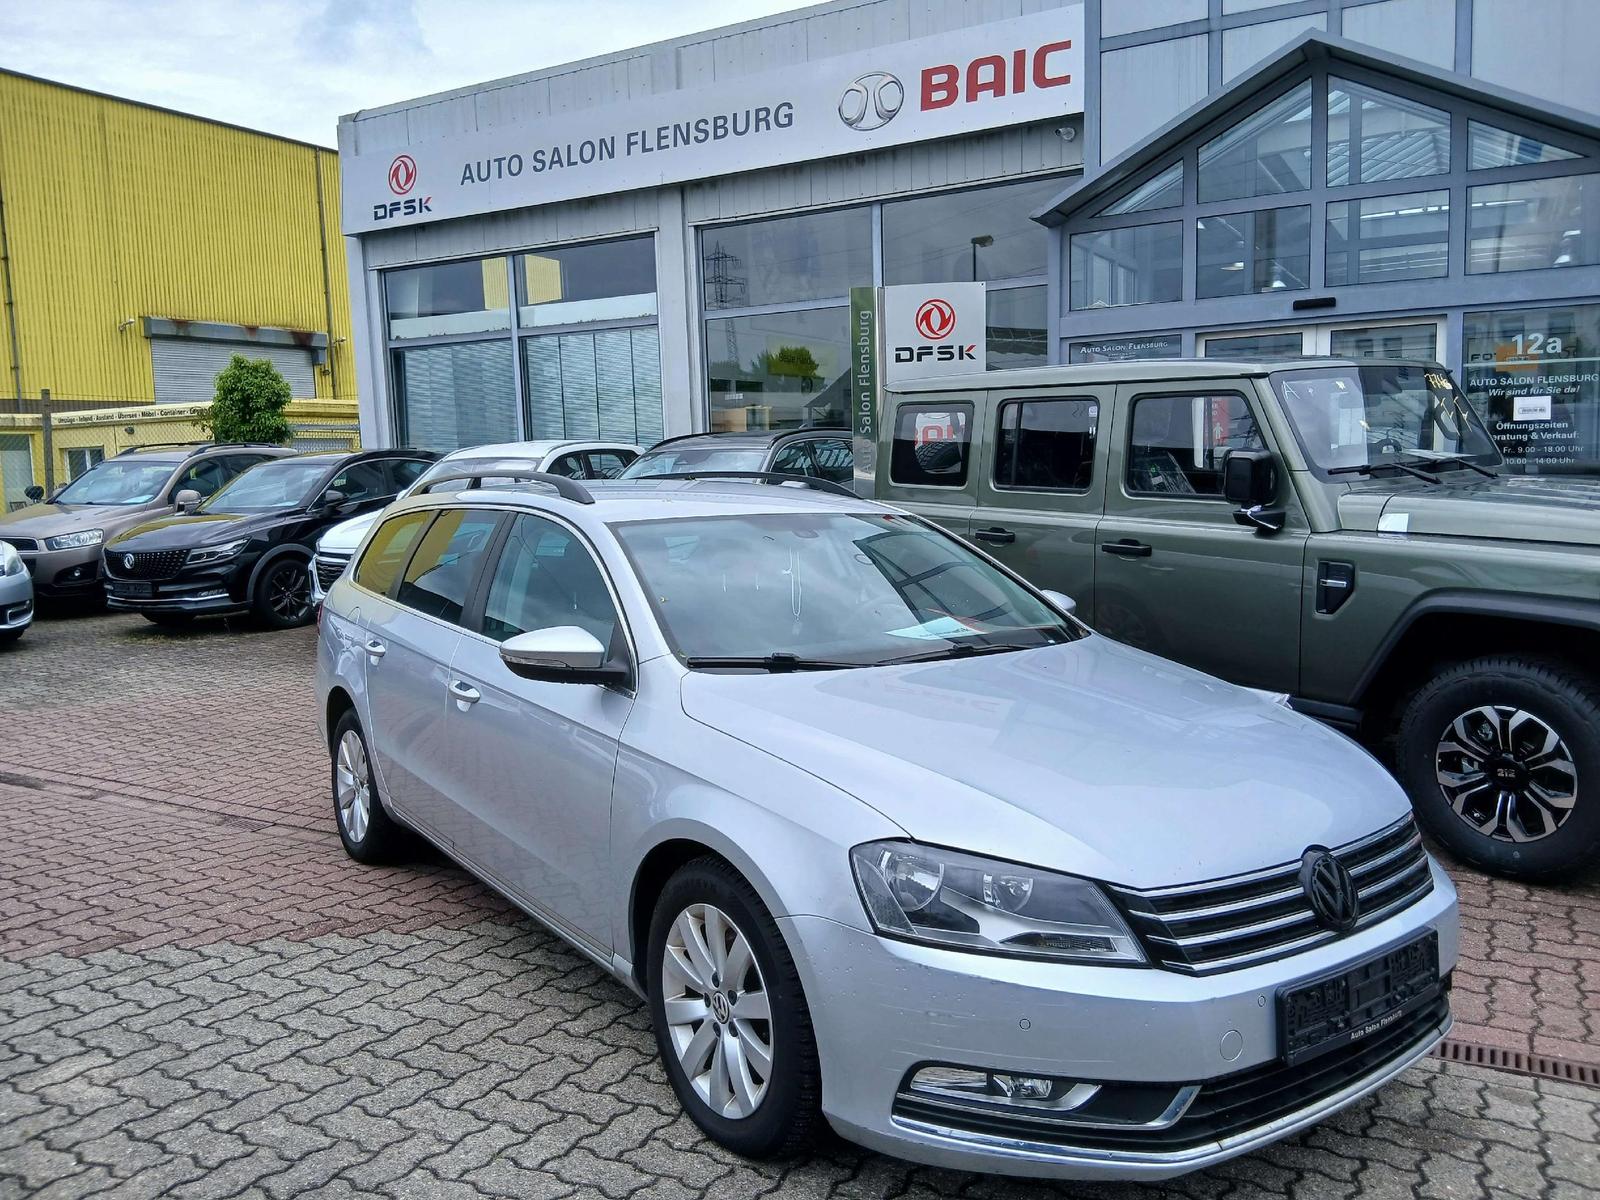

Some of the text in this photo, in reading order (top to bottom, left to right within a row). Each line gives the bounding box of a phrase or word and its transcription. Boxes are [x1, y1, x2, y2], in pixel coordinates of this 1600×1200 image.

[920, 40, 1072, 111] BAIC
[460, 102, 794, 186] AUTO SALON FLENSBURG
[373, 197, 432, 221] DFSK
[857, 310, 873, 386] Flensburg
[1511, 333, 1562, 355] 12a
[895, 345, 977, 363] DFSK
[1469, 374, 1599, 387] AUTO SALON FLENSBURG
[1488, 388, 1504, 397] Wir
[1506, 387, 1528, 396] sind
[1530, 386, 1543, 395] für
[1546, 386, 1562, 395] Sie
[117, 411, 138, 420] Übersee
[160, 409, 187, 417] Container
[858, 391, 872, 433] Salon
[1496, 421, 1569, 431] Öffnungszeiten
[1530, 432, 1540, 440] &
[1543, 445, 1566, 453] 18.00
[1568, 445, 1584, 453] Uhr
[1350, 1030, 1365, 1041] Auto
